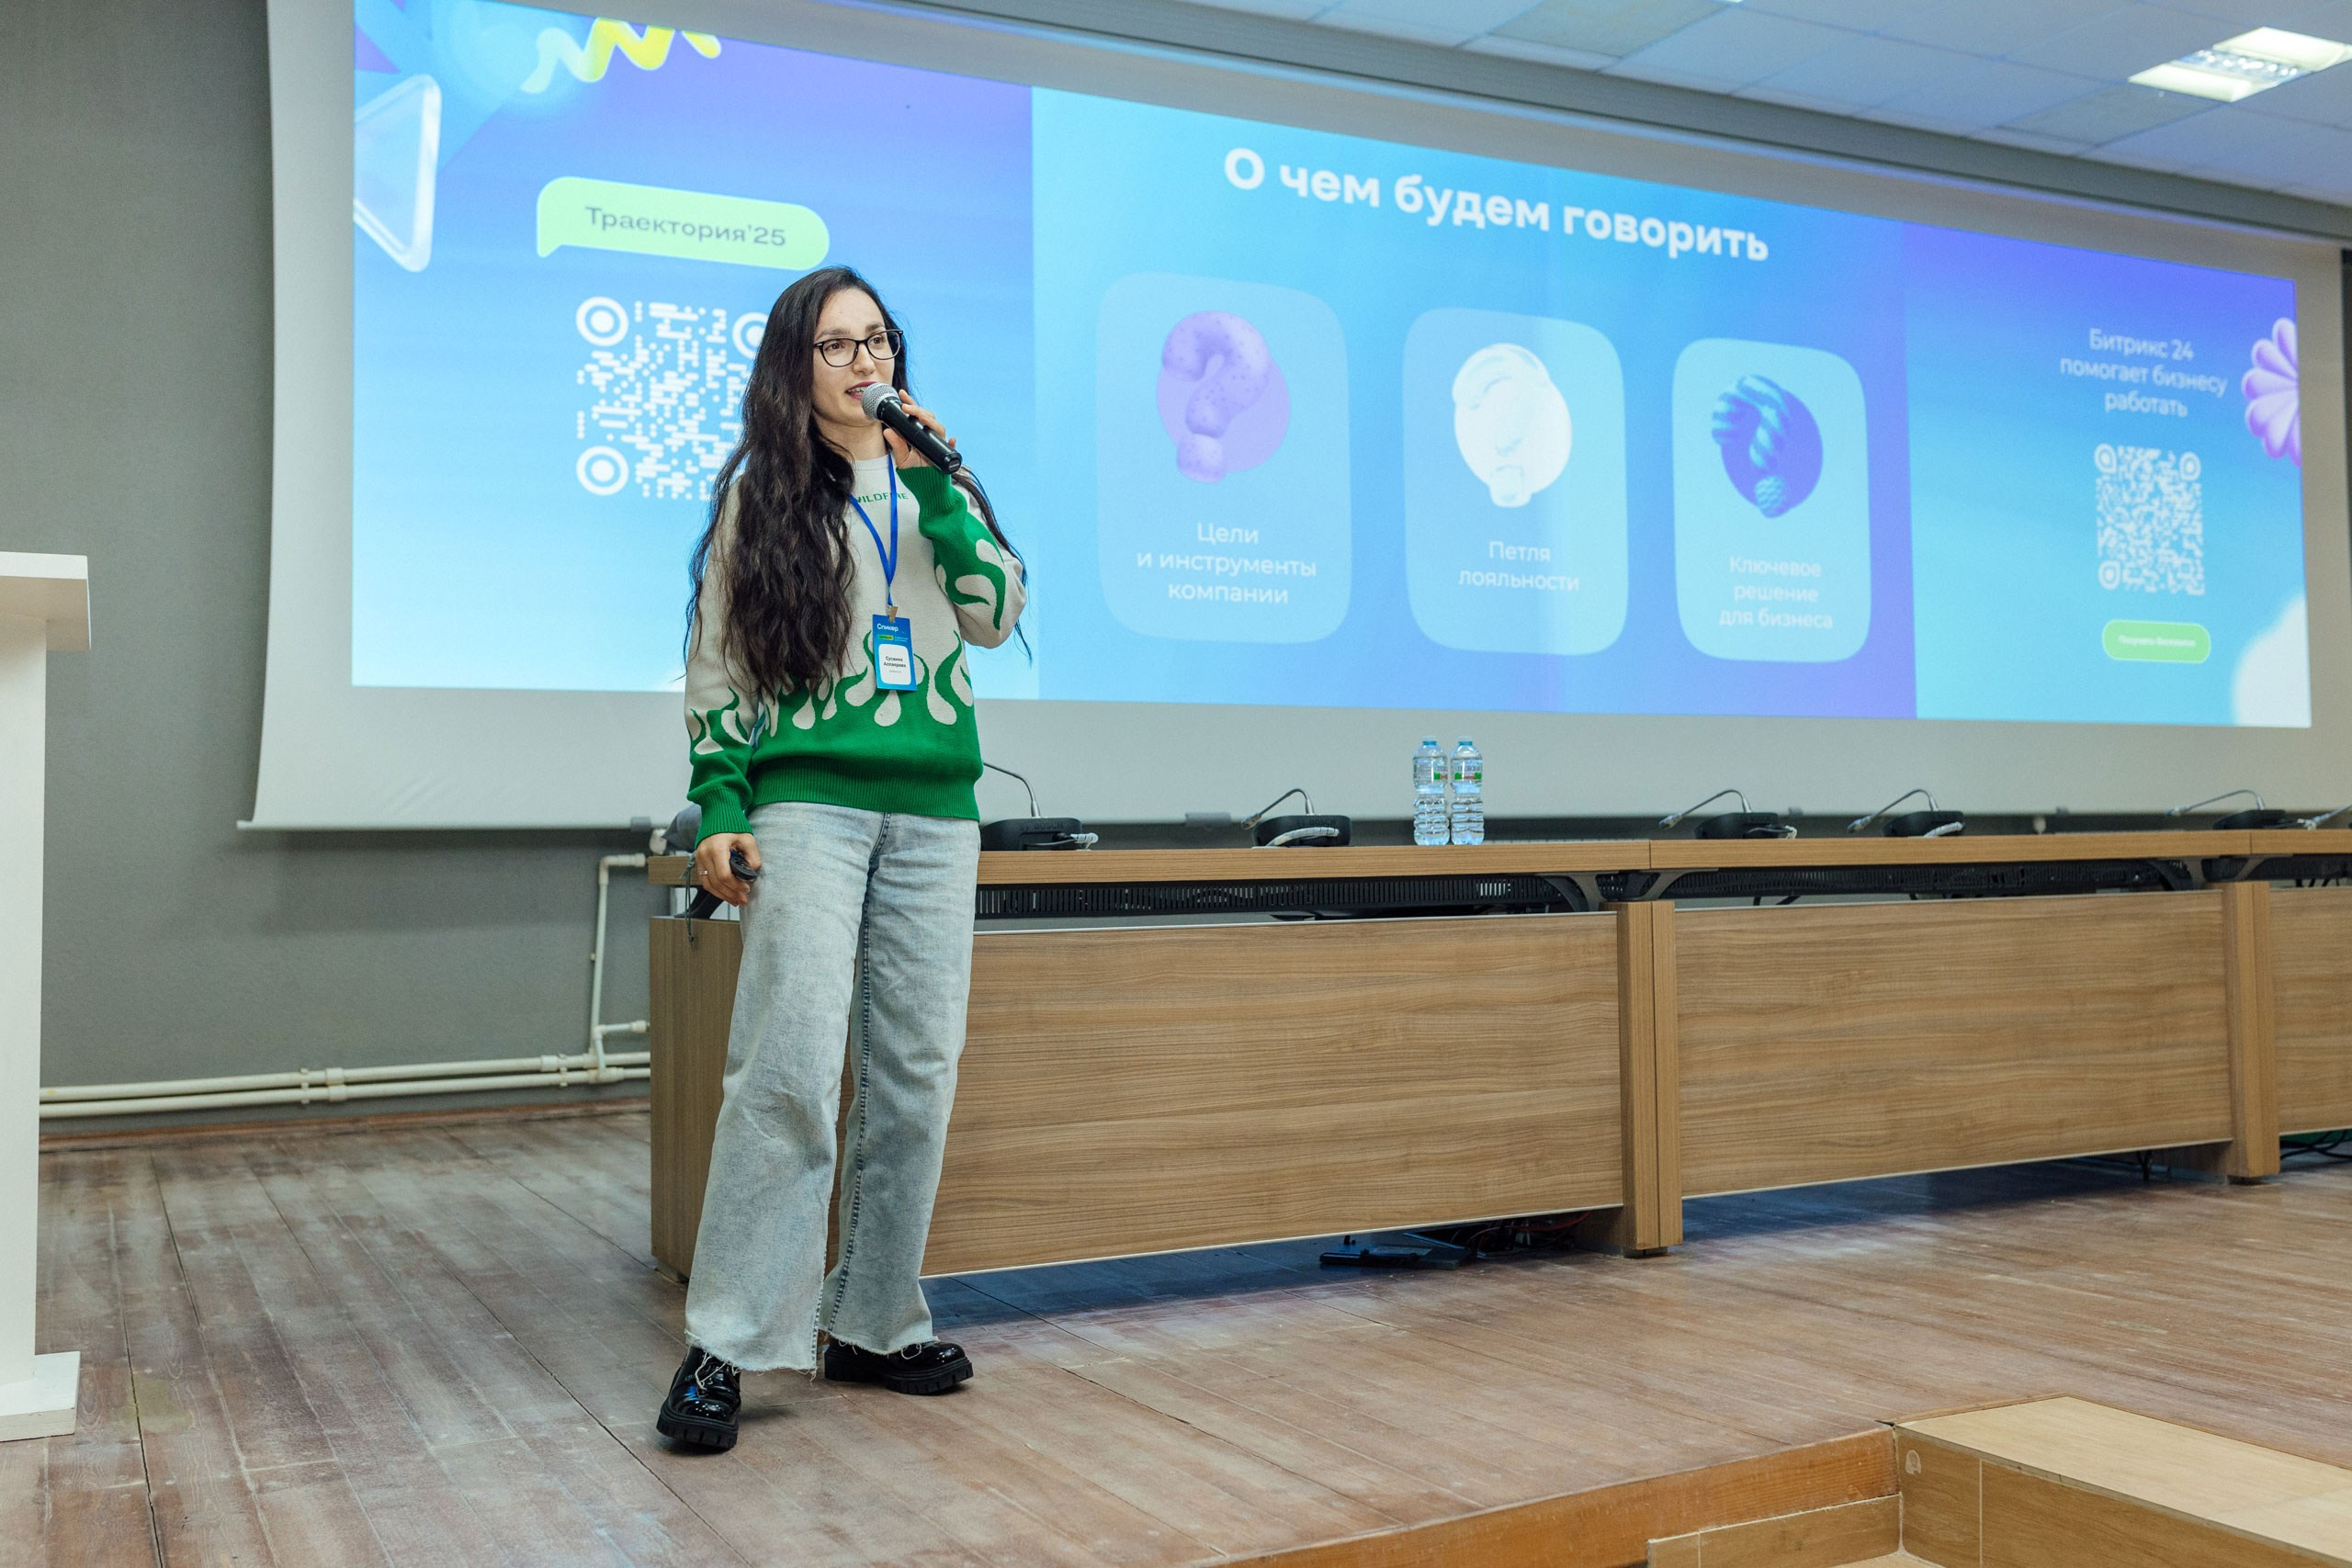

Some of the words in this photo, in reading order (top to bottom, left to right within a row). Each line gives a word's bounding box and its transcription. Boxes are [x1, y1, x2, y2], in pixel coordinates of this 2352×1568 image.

[1225, 147, 1265, 190] О
[1280, 164, 1380, 208] чем
[1395, 174, 1550, 231] будем
[1564, 205, 1769, 261] говорить
[585, 206, 786, 246] Траектория'25
[2089, 327, 2168, 359] Битрикс
[2171, 338, 2195, 362] 24
[2060, 357, 2149, 384] помогает
[2152, 364, 2228, 399] бизнесу
[2105, 389, 2188, 418] работать
[1197, 522, 1259, 546] Цели
[1488, 540, 1551, 562] Петля
[1136, 551, 1153, 568] и
[1159, 553, 1317, 578] инструменты
[1729, 556, 1822, 578] Ключевое
[1458, 570, 1580, 592] лояльности
[1168, 583, 1289, 604] компании
[1734, 585, 1819, 603] решение
[876, 623, 899, 633] Спикер
[1719, 609, 1754, 626] для
[1758, 606, 1834, 629] бизнеса
